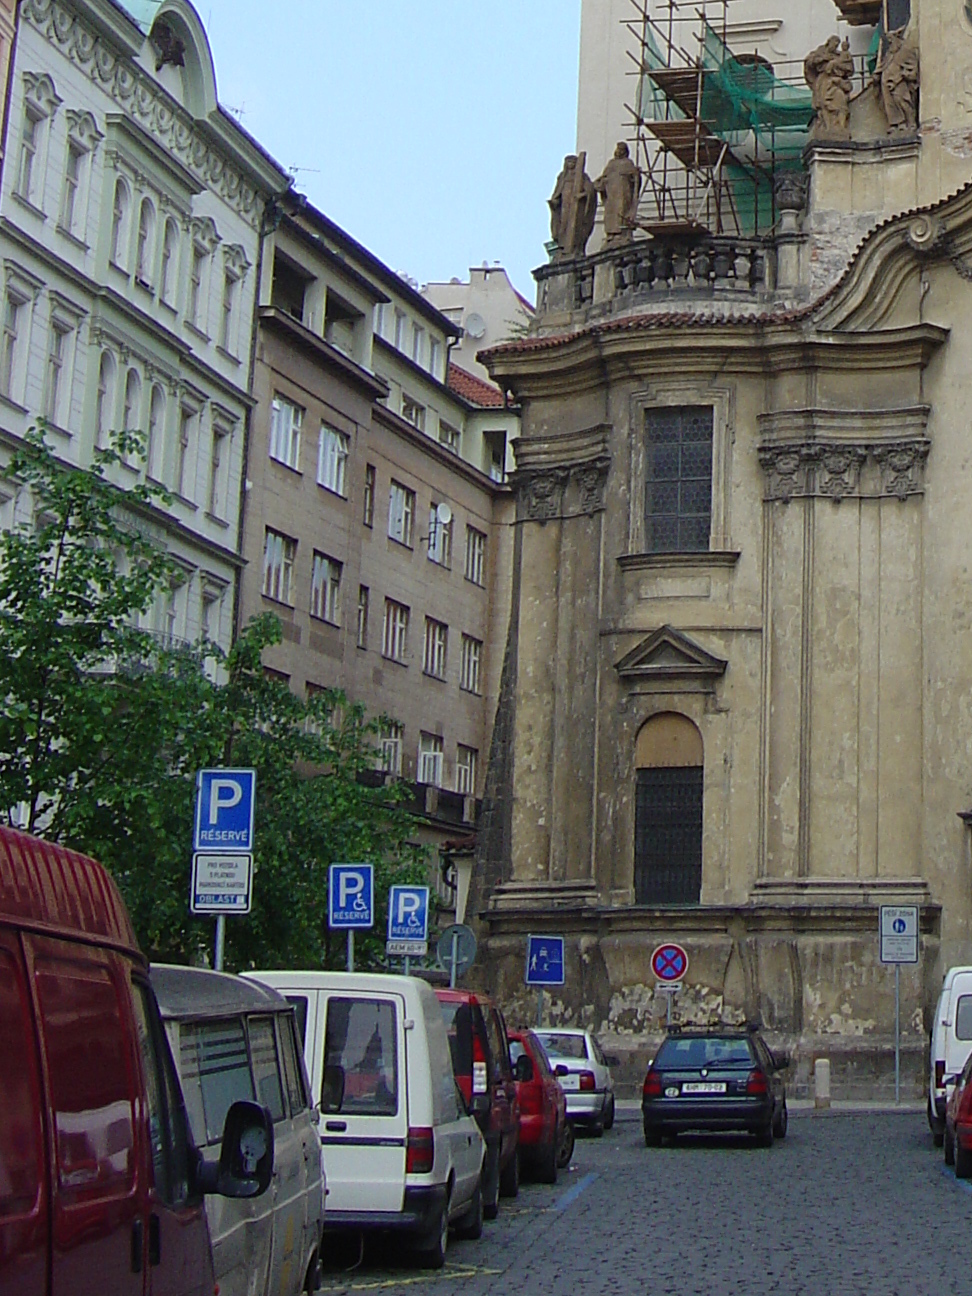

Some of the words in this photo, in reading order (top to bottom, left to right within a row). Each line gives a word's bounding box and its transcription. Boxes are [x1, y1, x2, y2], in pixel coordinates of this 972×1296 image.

[208, 778, 242, 825] P
[200, 828, 248, 841] RÉSERVÉ
[199, 894, 235, 904] OBLAST
[339, 871, 364, 908] P
[333, 906, 370, 920] RÉSERVÉ
[397, 892, 420, 923] P
